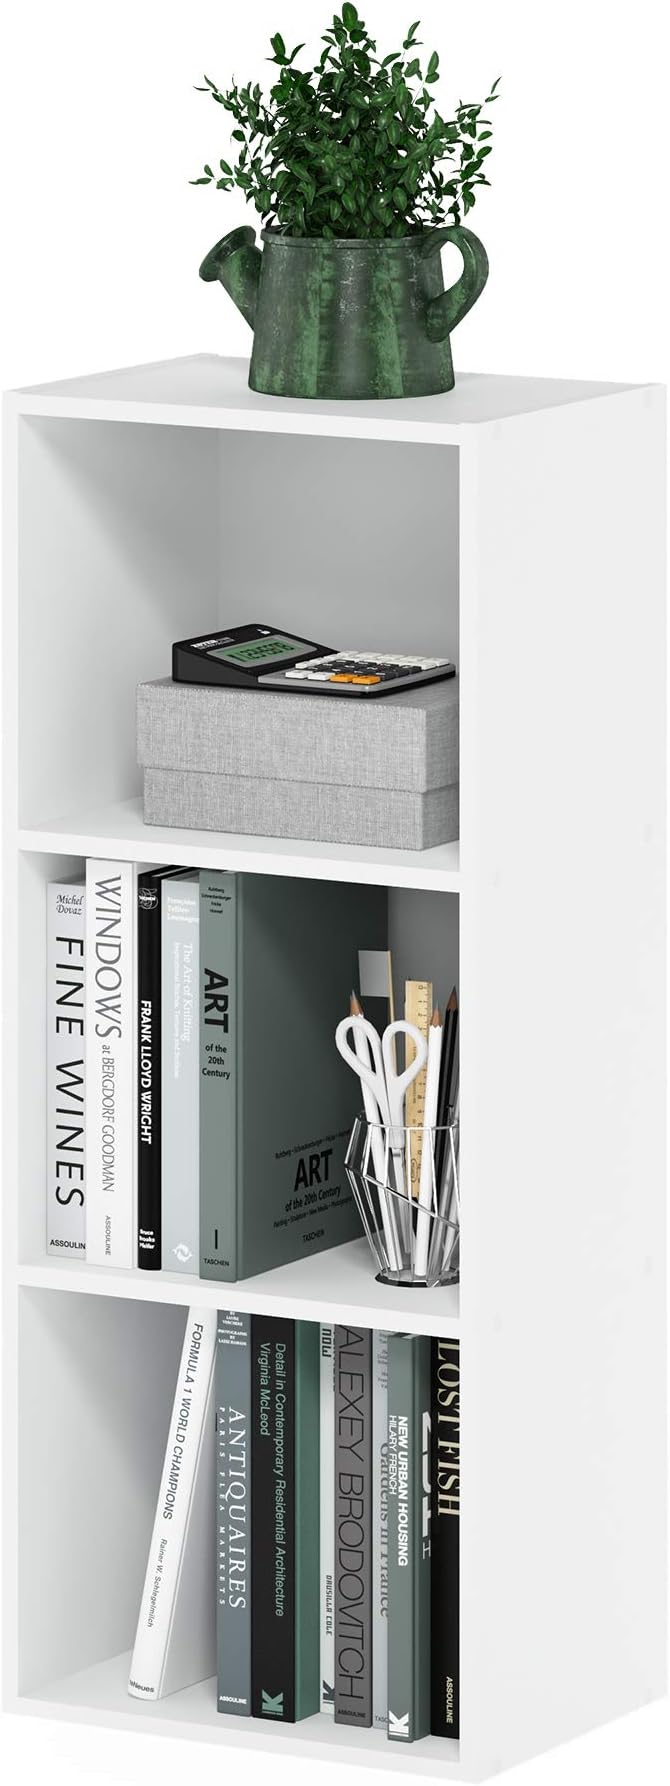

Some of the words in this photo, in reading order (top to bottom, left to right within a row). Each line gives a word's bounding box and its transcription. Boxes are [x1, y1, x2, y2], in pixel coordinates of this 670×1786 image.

[55, 904, 83, 915] Dovaz
[56, 894, 84, 906] Michel
[94, 875, 122, 1038] WINDOWS
[56, 936, 84, 1036] FINE
[204, 968, 229, 1033] ART
[140, 1000, 152, 1042] FRANK
[102, 1044, 110, 1054] at
[140, 1045, 152, 1088] LLOYD
[205, 1043, 213, 1052] of
[215, 1044, 227, 1054] the
[208, 1056, 224, 1065] 20th
[101, 1055, 115, 1123] BERGDORF
[202, 1067, 231, 1080] Century
[56, 1059, 84, 1206] WINES
[140, 1091, 152, 1144] WRIGHT
[101, 1124, 115, 1192] GOODMAN
[293, 1148, 333, 1192] ART
[293, 1198, 303, 1210] the
[304, 1191, 318, 1206] 20th
[318, 1186, 341, 1201] Century
[50, 1239, 86, 1249] ASSOULIN
[204, 1258, 230, 1267] TASCHEN
[185, 1322, 204, 1383] FORMULA
[258, 1342, 270, 1385] Virginia
[275, 1343, 286, 1376] Detail
[275, 1380, 286, 1390] in
[338, 1324, 364, 1462] ALEXEY
[437, 1340, 460, 1432] LOST
[175, 1398, 192, 1443] WORLD
[260, 1388, 270, 1436] McLeod
[273, 1393, 286, 1477] Contemporary
[389, 1415, 397, 1451] HILARY
[398, 1415, 408, 1443] NEW
[162, 1445, 184, 1520] CHAMPIONS
[389, 1452, 397, 1495] FRENCH
[398, 1445, 408, 1499] URBAN
[437, 1437, 460, 1516] FISH
[225, 1406, 246, 1608] ANTIQUAIRES
[275, 1479, 286, 1544] Residential
[158, 1538, 168, 1567] Rainer
[398, 1501, 408, 1566] HOUSING
[275, 1546, 286, 1617] Architecture
[338, 1472, 364, 1699] BRODOVITCH
[375, 1715, 388, 1723] TASC
[446, 1676, 454, 1724] ASSOULINE
